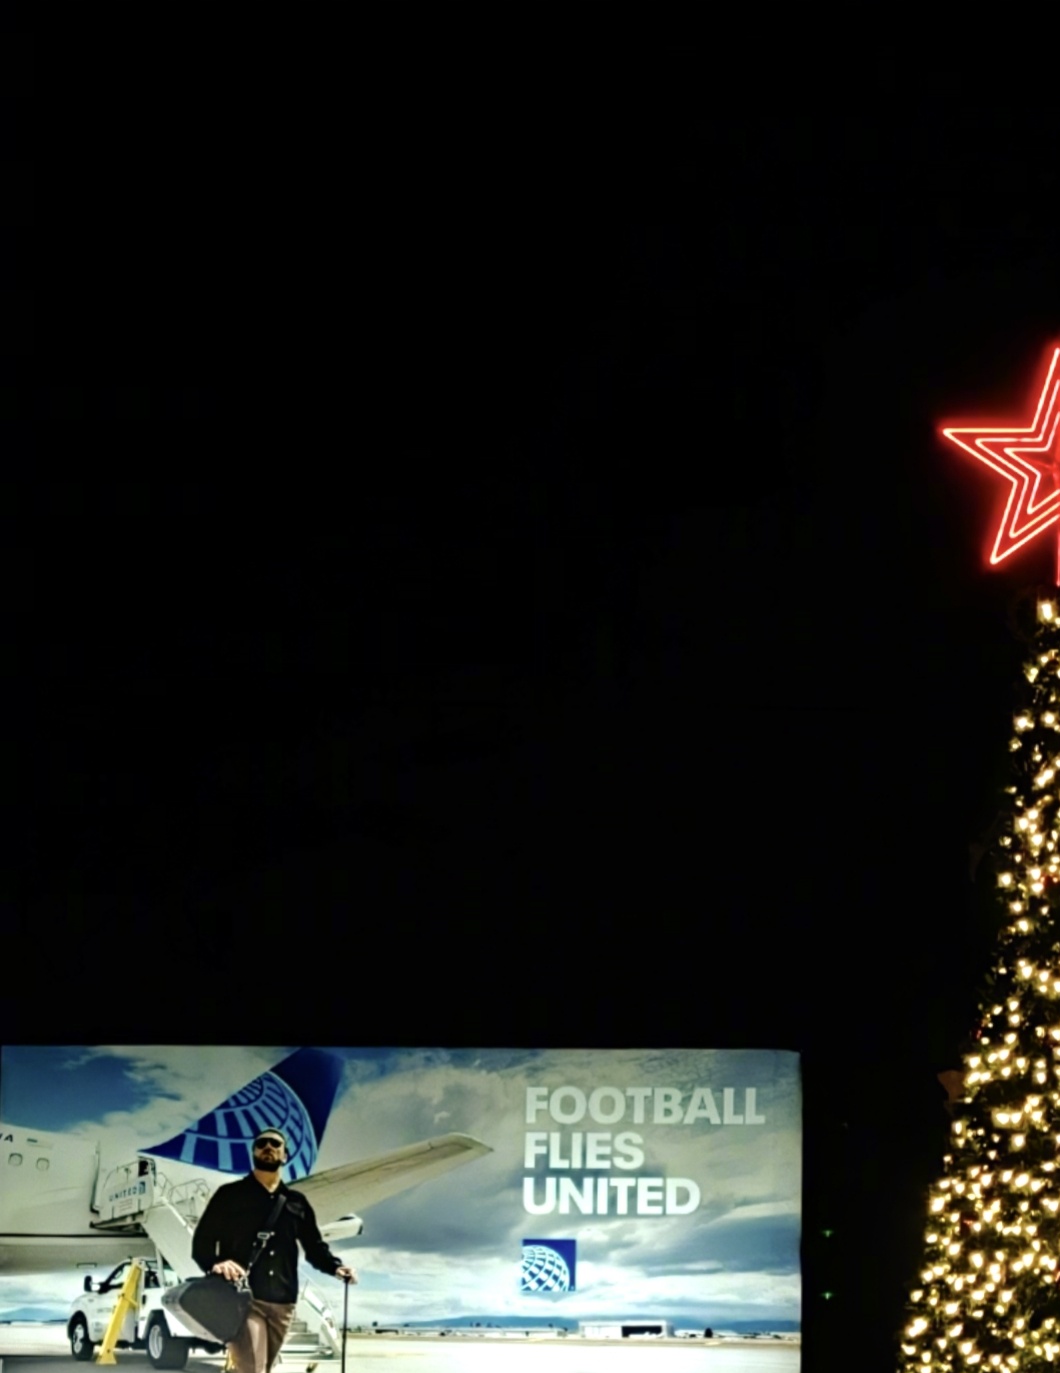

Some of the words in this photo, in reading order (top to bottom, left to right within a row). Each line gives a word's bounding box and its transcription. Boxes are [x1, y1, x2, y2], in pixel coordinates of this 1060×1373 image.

[525, 1086, 765, 1125] FOOTBALL
[524, 1131, 645, 1169] FLIES
[109, 1186, 138, 1202] UNITED
[522, 1177, 701, 1215] UNITED
